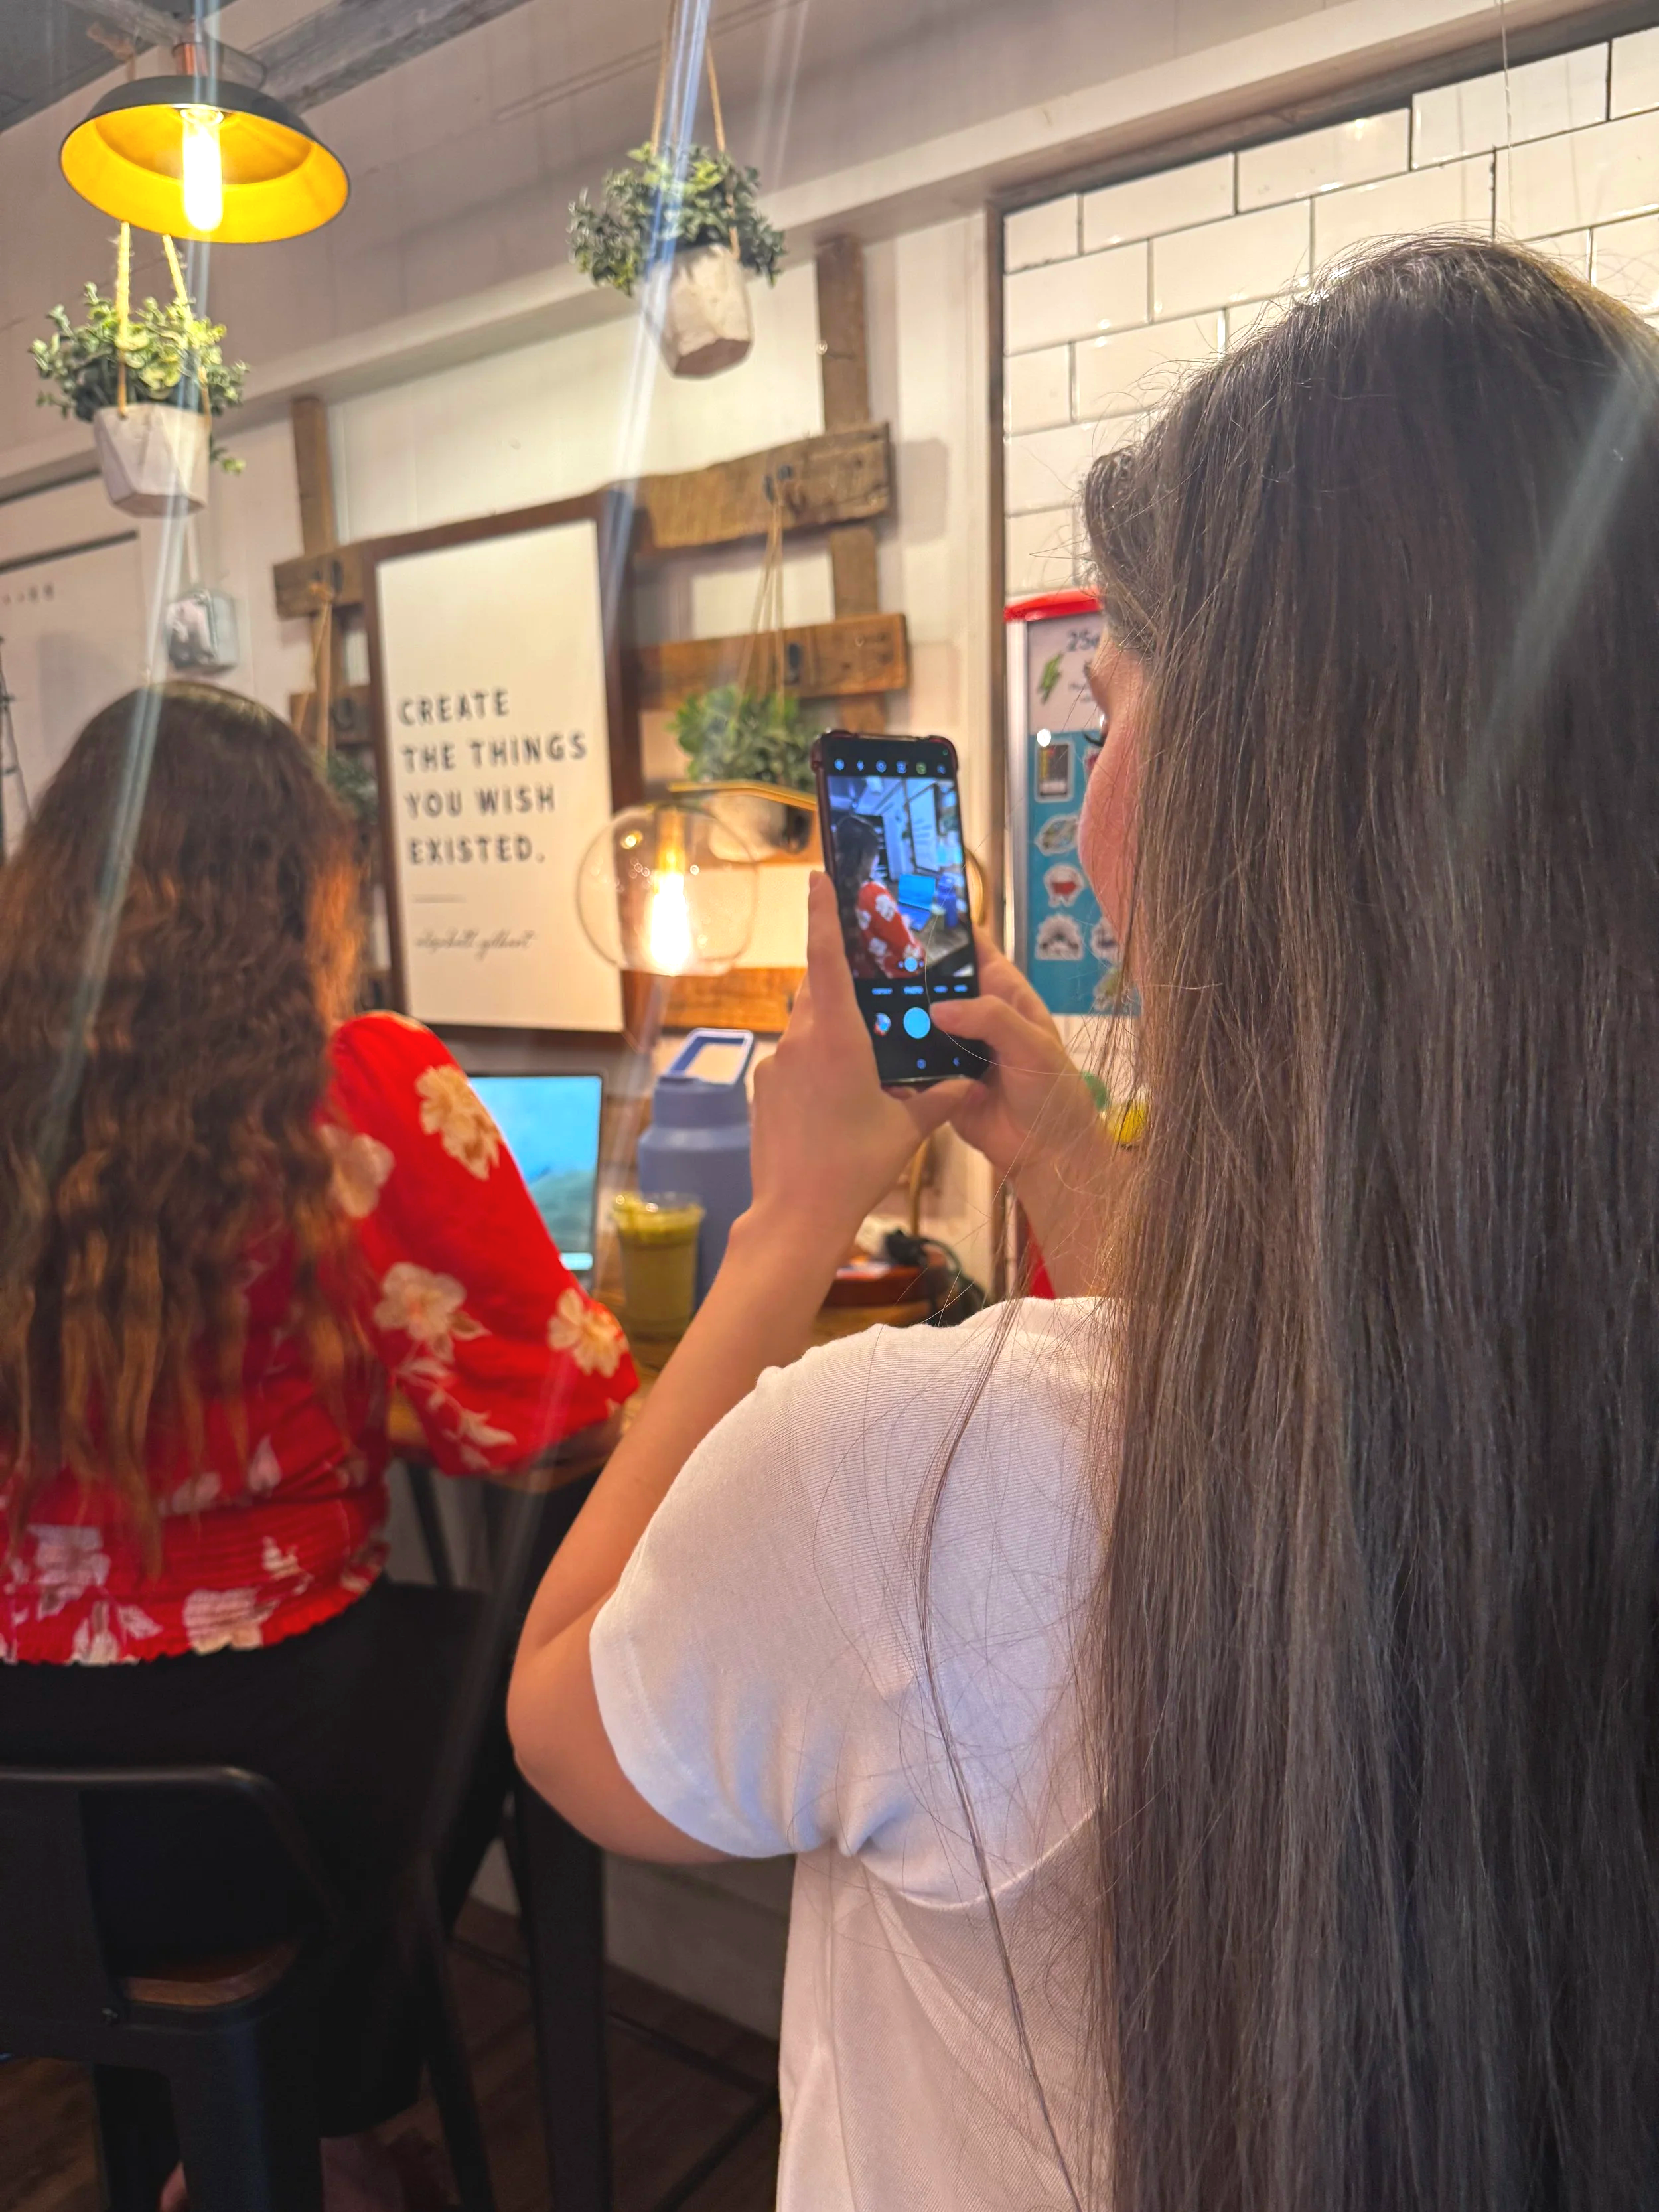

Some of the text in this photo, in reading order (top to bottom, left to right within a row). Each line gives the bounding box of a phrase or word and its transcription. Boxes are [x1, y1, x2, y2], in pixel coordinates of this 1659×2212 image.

[399, 688, 509, 725] CREATE
[402, 732, 587, 773] THE THINGS
[405, 785, 556, 819] YOU WISH
[409, 834, 545, 865] EXISTED.
